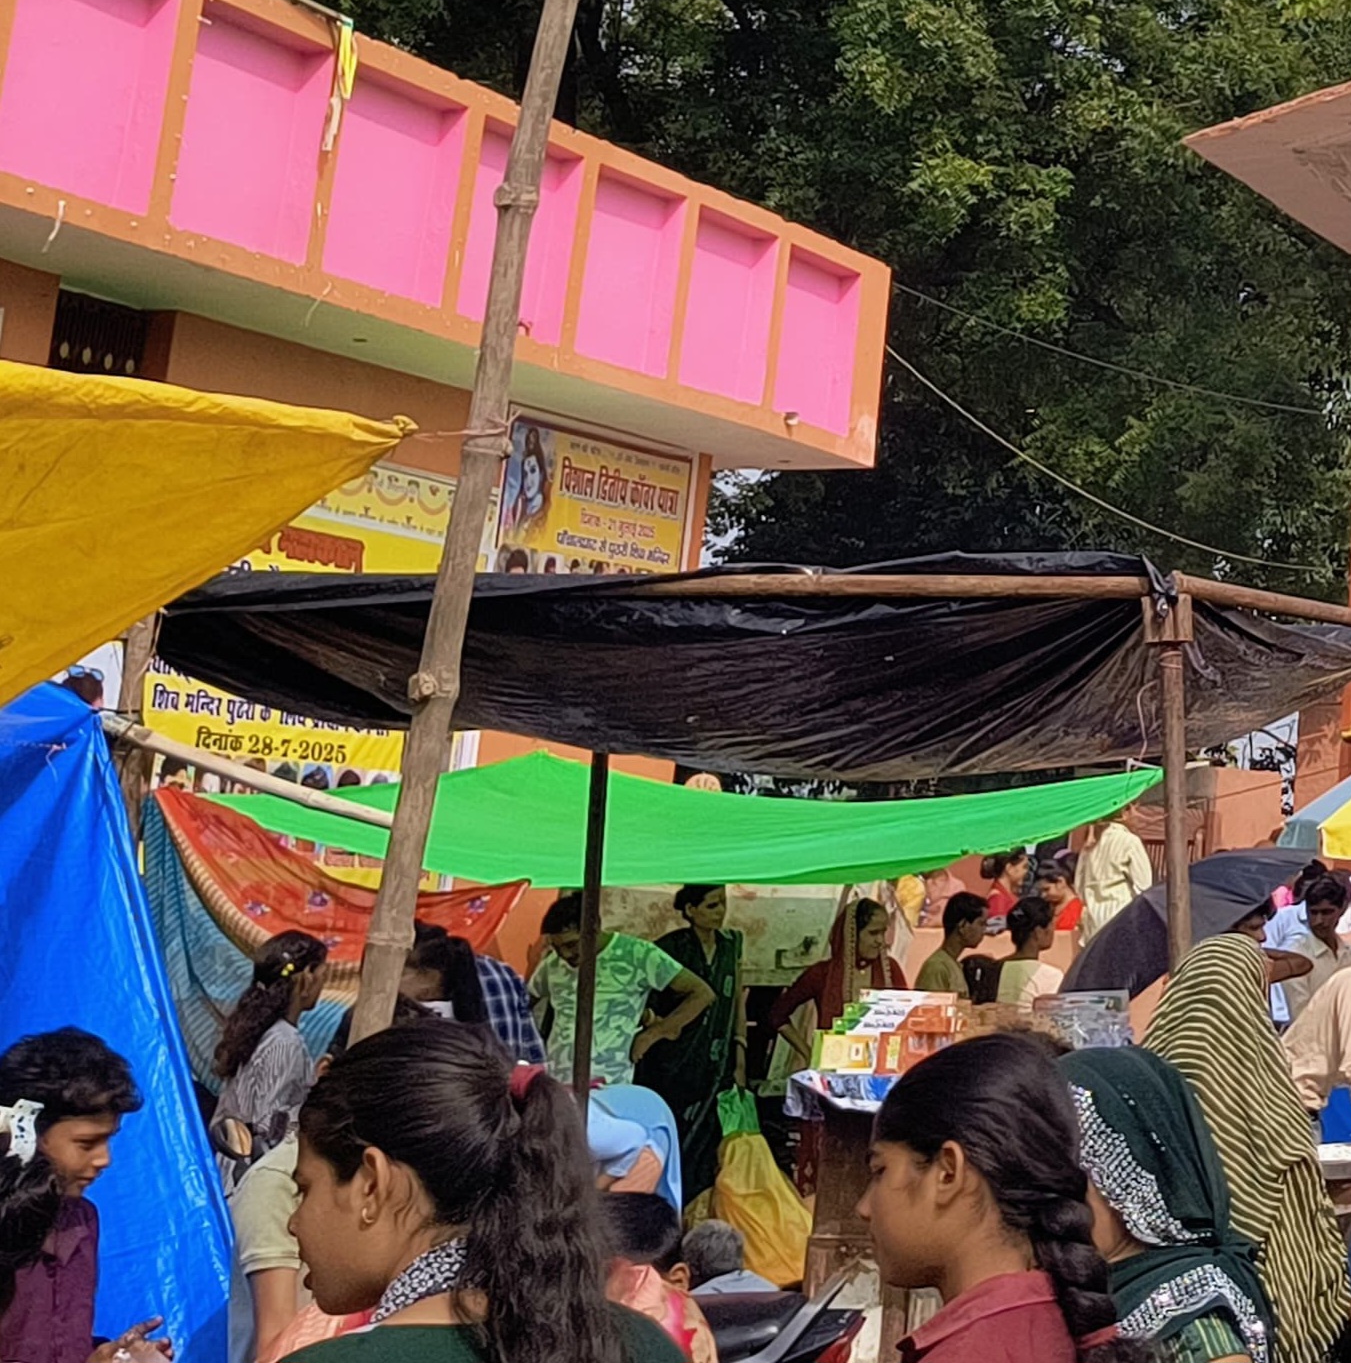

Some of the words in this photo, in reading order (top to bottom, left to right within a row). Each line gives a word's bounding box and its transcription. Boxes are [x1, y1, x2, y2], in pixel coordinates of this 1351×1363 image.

[152, 683, 180, 712] शिव
[184, 689, 222, 717] मन्दिर
[195, 725, 246, 752] दिनांक
[247, 733, 348, 764] 28-7-2025
